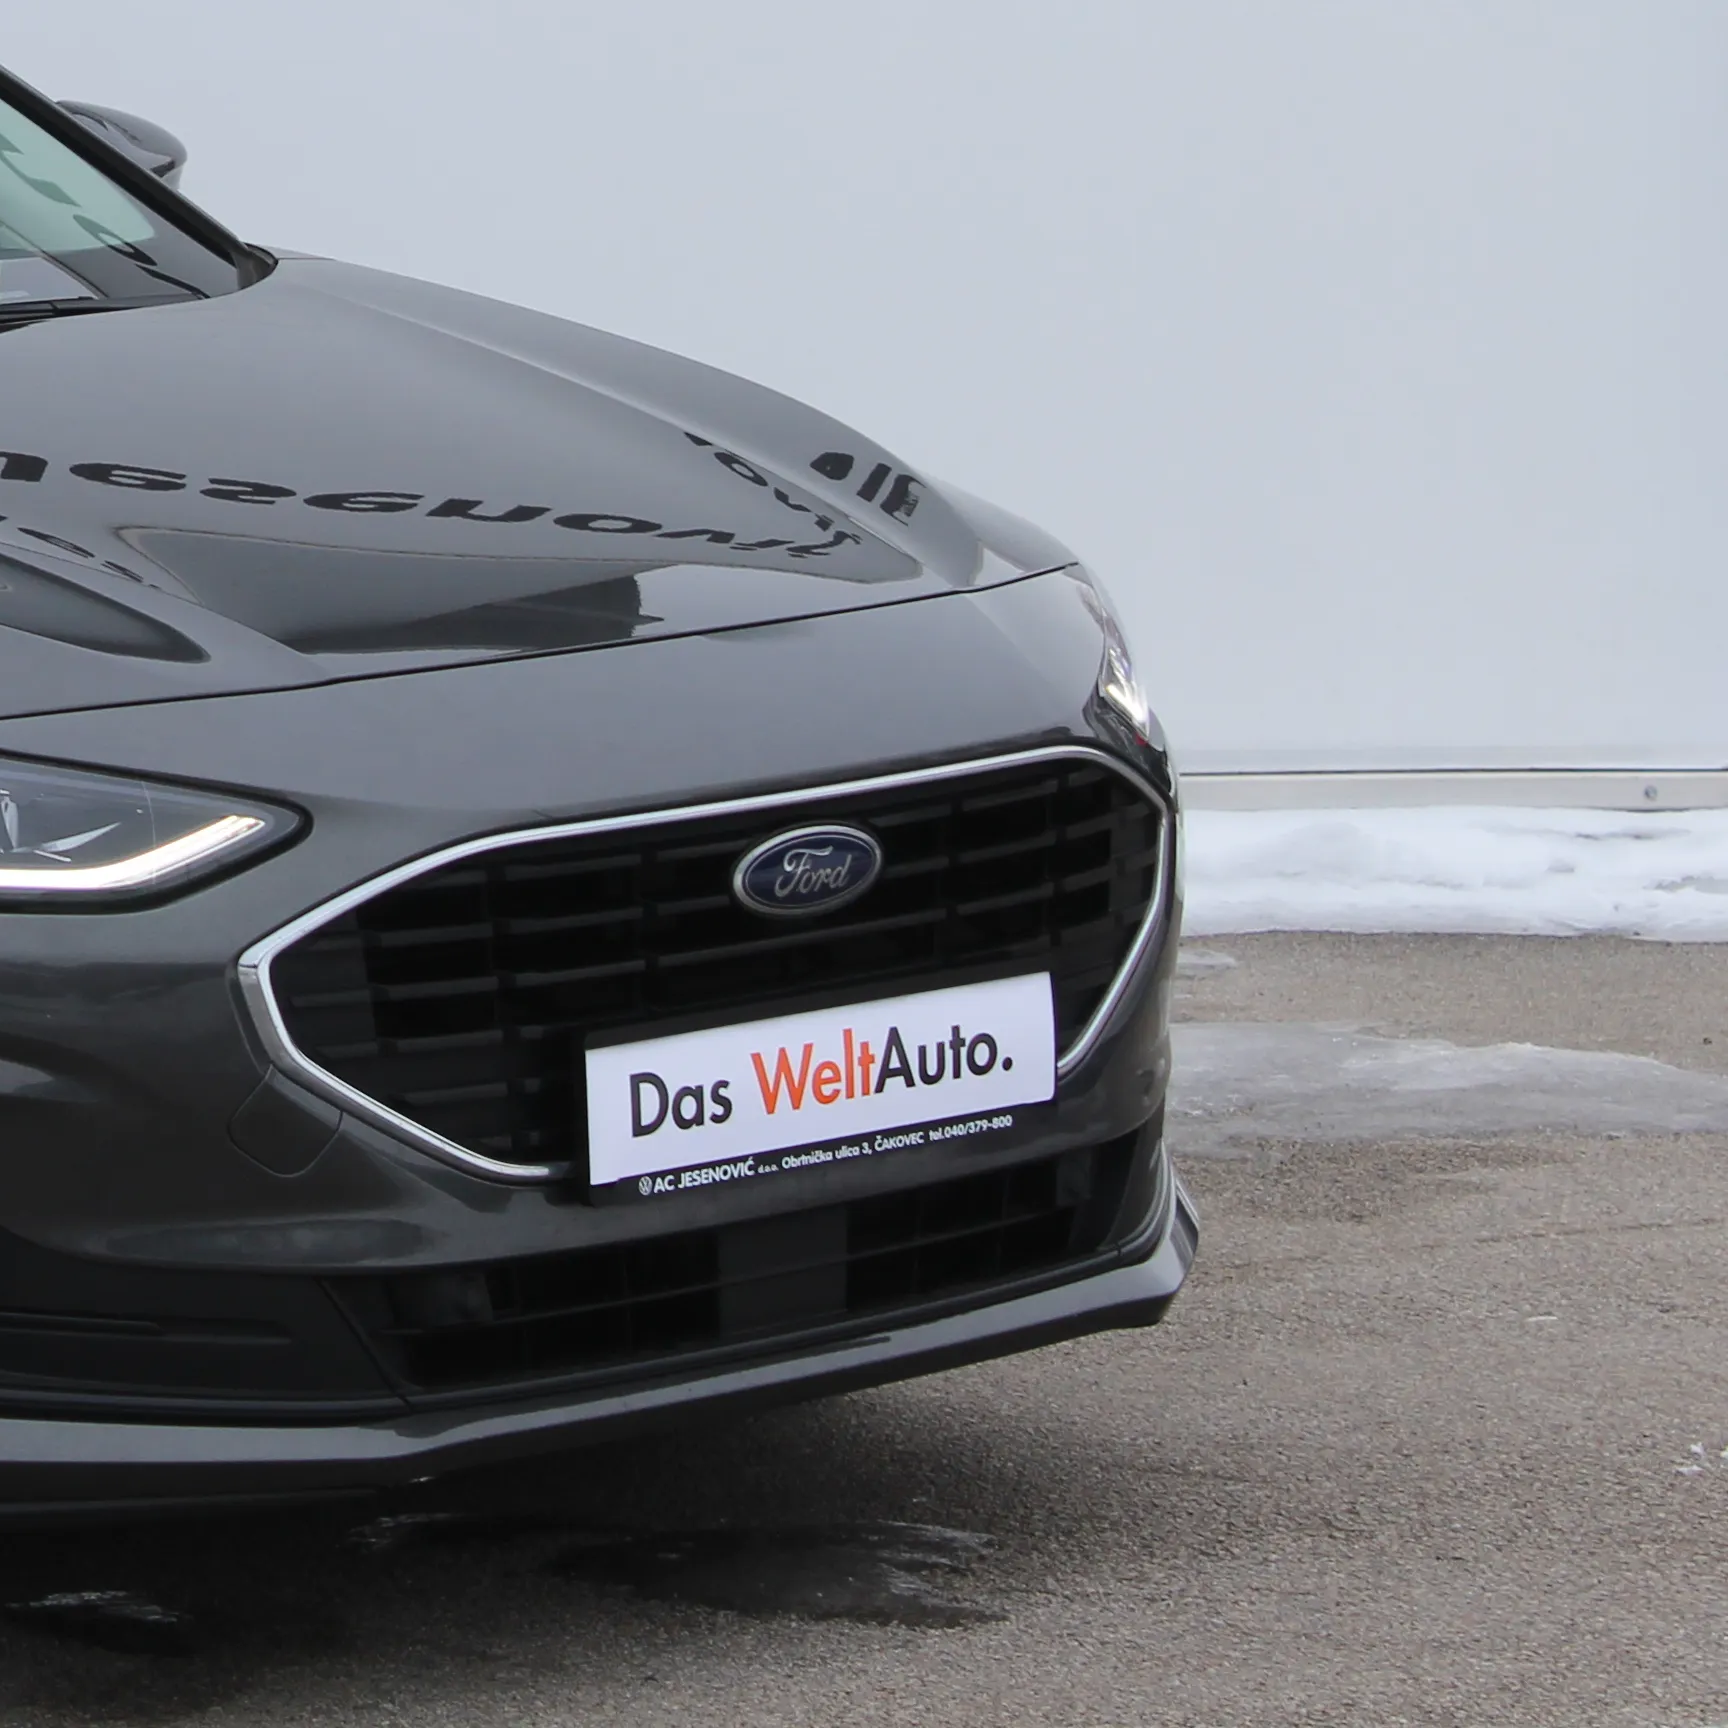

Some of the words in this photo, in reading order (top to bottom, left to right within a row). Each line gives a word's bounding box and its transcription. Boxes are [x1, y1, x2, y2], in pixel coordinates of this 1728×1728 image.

[774, 845, 852, 897] Ford
[630, 1072, 732, 1138] Das
[750, 1025, 1014, 1115] WeltAuto.
[677, 1157, 755, 1189] JESENOVIĆ
[781, 1150, 833, 1169] Obrtnička
[834, 1145, 860, 1159] ulica
[874, 1132, 924, 1152] ČAKOVEC
